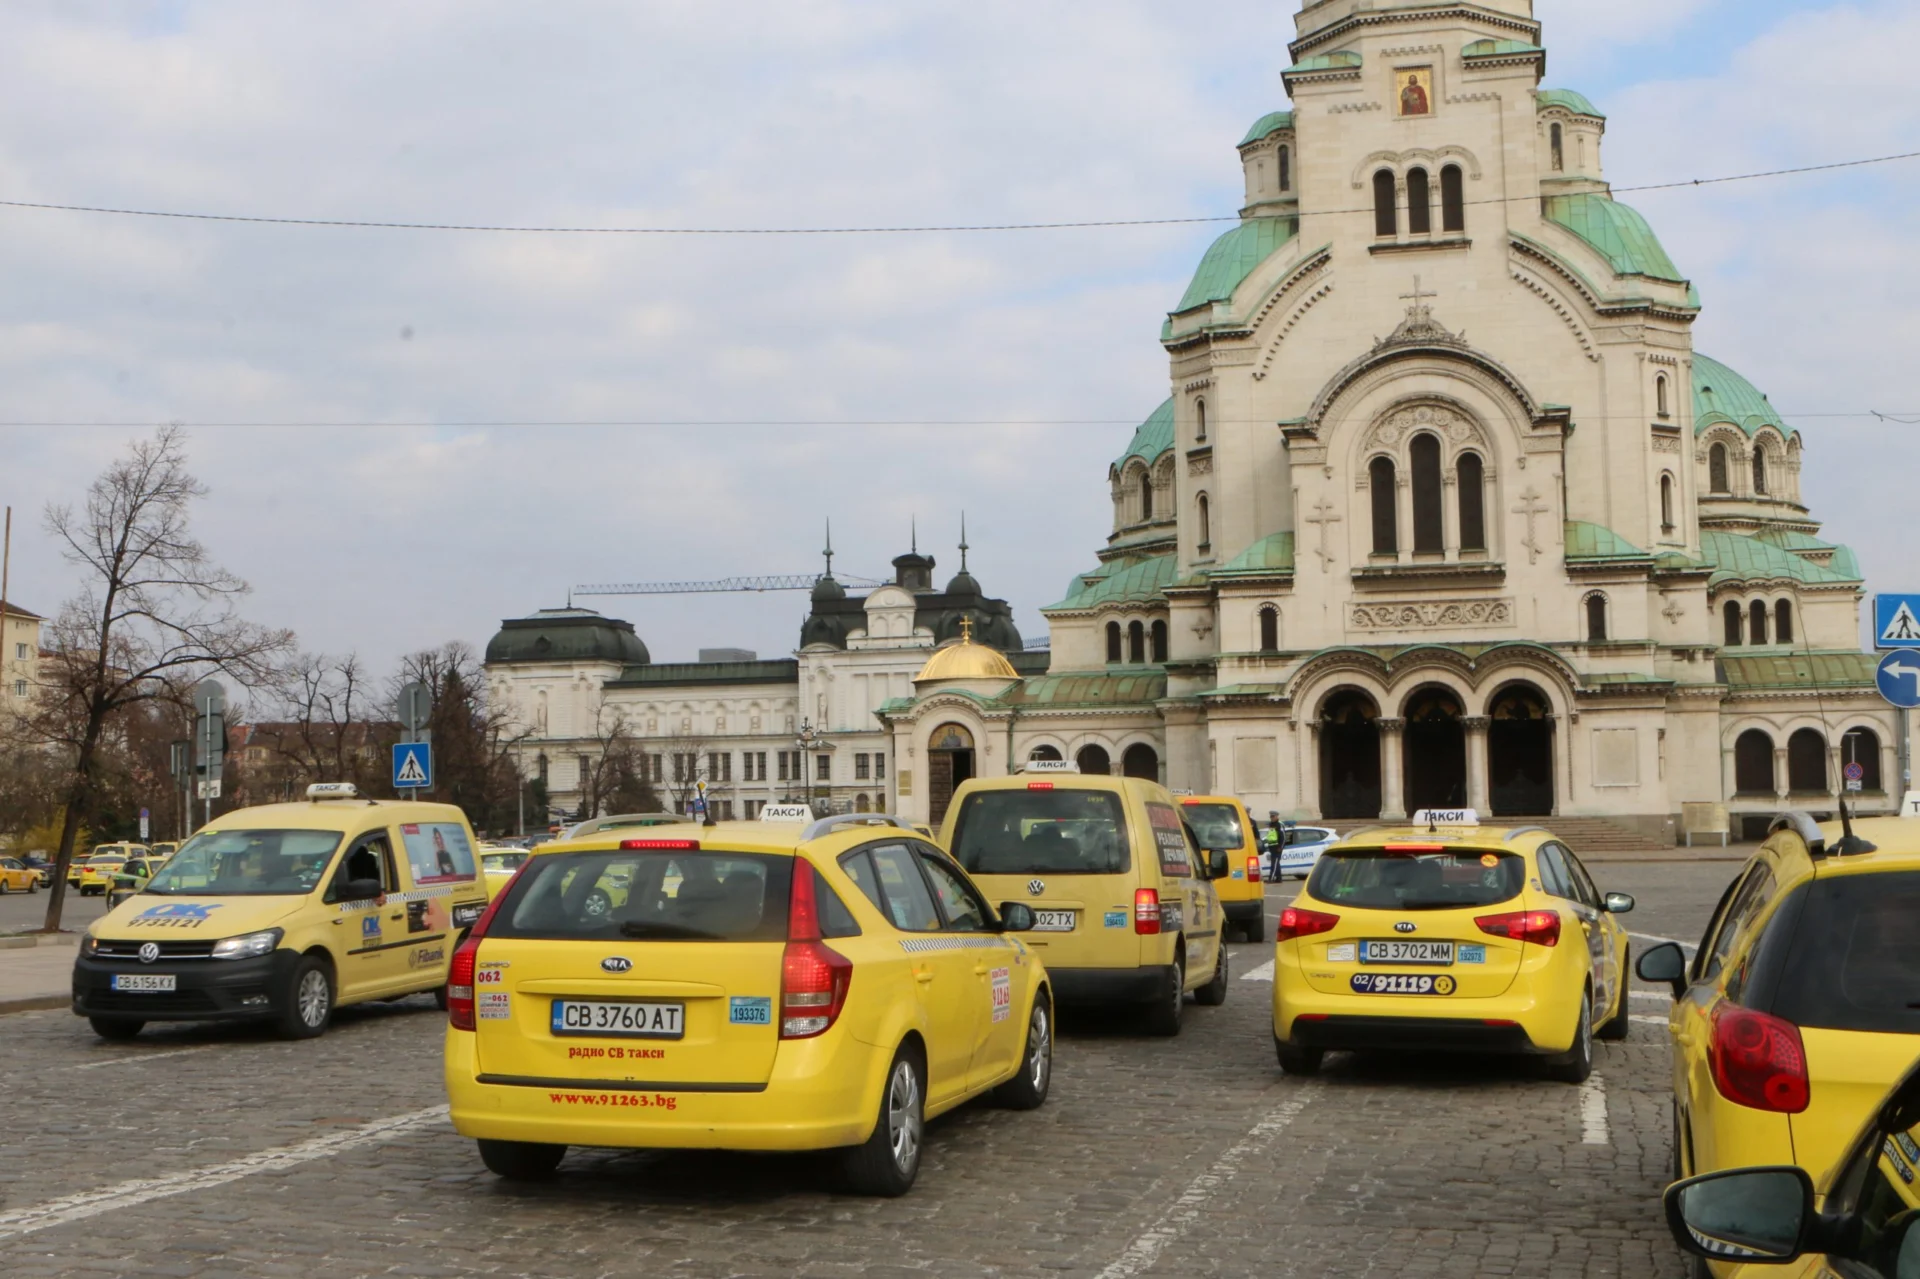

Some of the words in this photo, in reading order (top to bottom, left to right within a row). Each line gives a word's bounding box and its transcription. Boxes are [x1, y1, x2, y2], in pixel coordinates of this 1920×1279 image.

[315, 784, 341, 792] ТАКСИ
[766, 808, 805, 817] ТАКСИ
[1423, 811, 1464, 821] ТАКСИ
[1281, 851, 1314, 861] ОЛИЦИЯ
[127, 919, 205, 929] 9732121
[1036, 913, 1054, 925] 02
[1056, 913, 1072, 925] TX
[1396, 923, 1413, 931] KIA
[1369, 943, 1388, 958] CB
[1392, 944, 1427, 959] 3702
[1431, 945, 1450, 959] MM
[604, 960, 627, 969] KIA
[478, 971, 500, 982] 062
[118, 977, 132, 988] CB
[133, 977, 158, 989] 6156
[159, 977, 174, 989] KX
[1353, 975, 1432, 992] 02/91119
[565, 1005, 591, 1027] CB
[596, 1006, 647, 1029] 3760
[651, 1008, 679, 1030] AT
[733, 1007, 766, 1021] 193376
[568, 1047, 605, 1059] радио
[608, 1047, 625, 1058] СВ
[628, 1049, 665, 1059] такси
[549, 1093, 677, 1110] www.91263.bg
